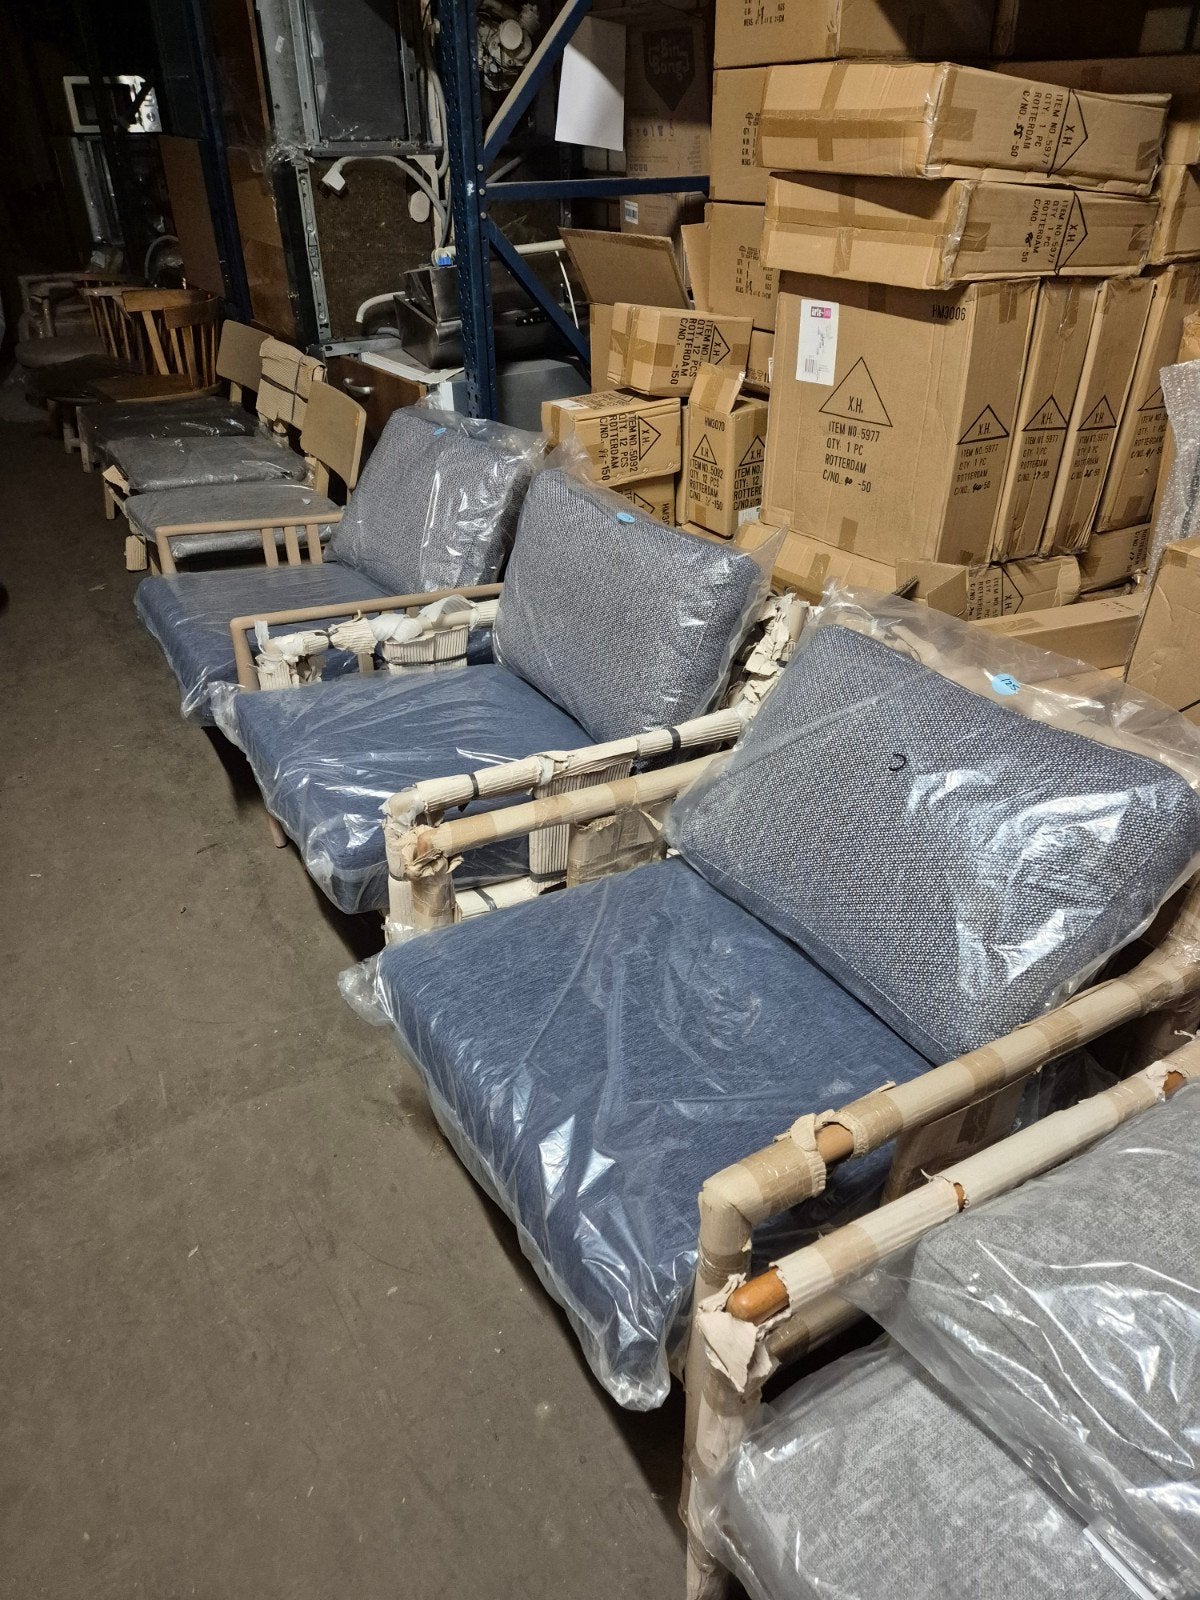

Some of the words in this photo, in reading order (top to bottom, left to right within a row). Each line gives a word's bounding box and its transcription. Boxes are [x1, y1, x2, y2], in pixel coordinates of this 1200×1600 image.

[1052, 94, 1063, 117] ITEM
[1023, 92, 1042, 149] ROTTERDAM
[1035, 135, 1043, 147] PC
[1059, 200, 1068, 220] ITEM
[1033, 200, 1050, 253] ROTTERDAM
[932, 304, 966, 321] HM3006
[703, 320, 714, 341] ITEM
[681, 318, 697, 377] ROTTERDAM
[693, 346, 700, 355] 12
[689, 360, 698, 377] PCS
[828, 421, 845, 435] ITEM
[609, 415, 619, 469] ROTTERDAM
[620, 438, 627, 447] 12
[847, 442, 850, 453] 1
[854, 443, 863, 455] PC
[961, 449, 973, 458] ITEM
[690, 459, 701, 470] ITEM
[825, 453, 867, 474] ROTTERDAM
[1021, 459, 1048, 470] ROTTERDAM
[735, 468, 750, 479] ITEM
[957, 469, 988, 482] ROTTERDAM
[690, 479, 718, 498] ROTTERDAM
[710, 476, 719, 488] PCS
[734, 478, 749, 490] QTY:
[752, 476, 760, 486] 12
